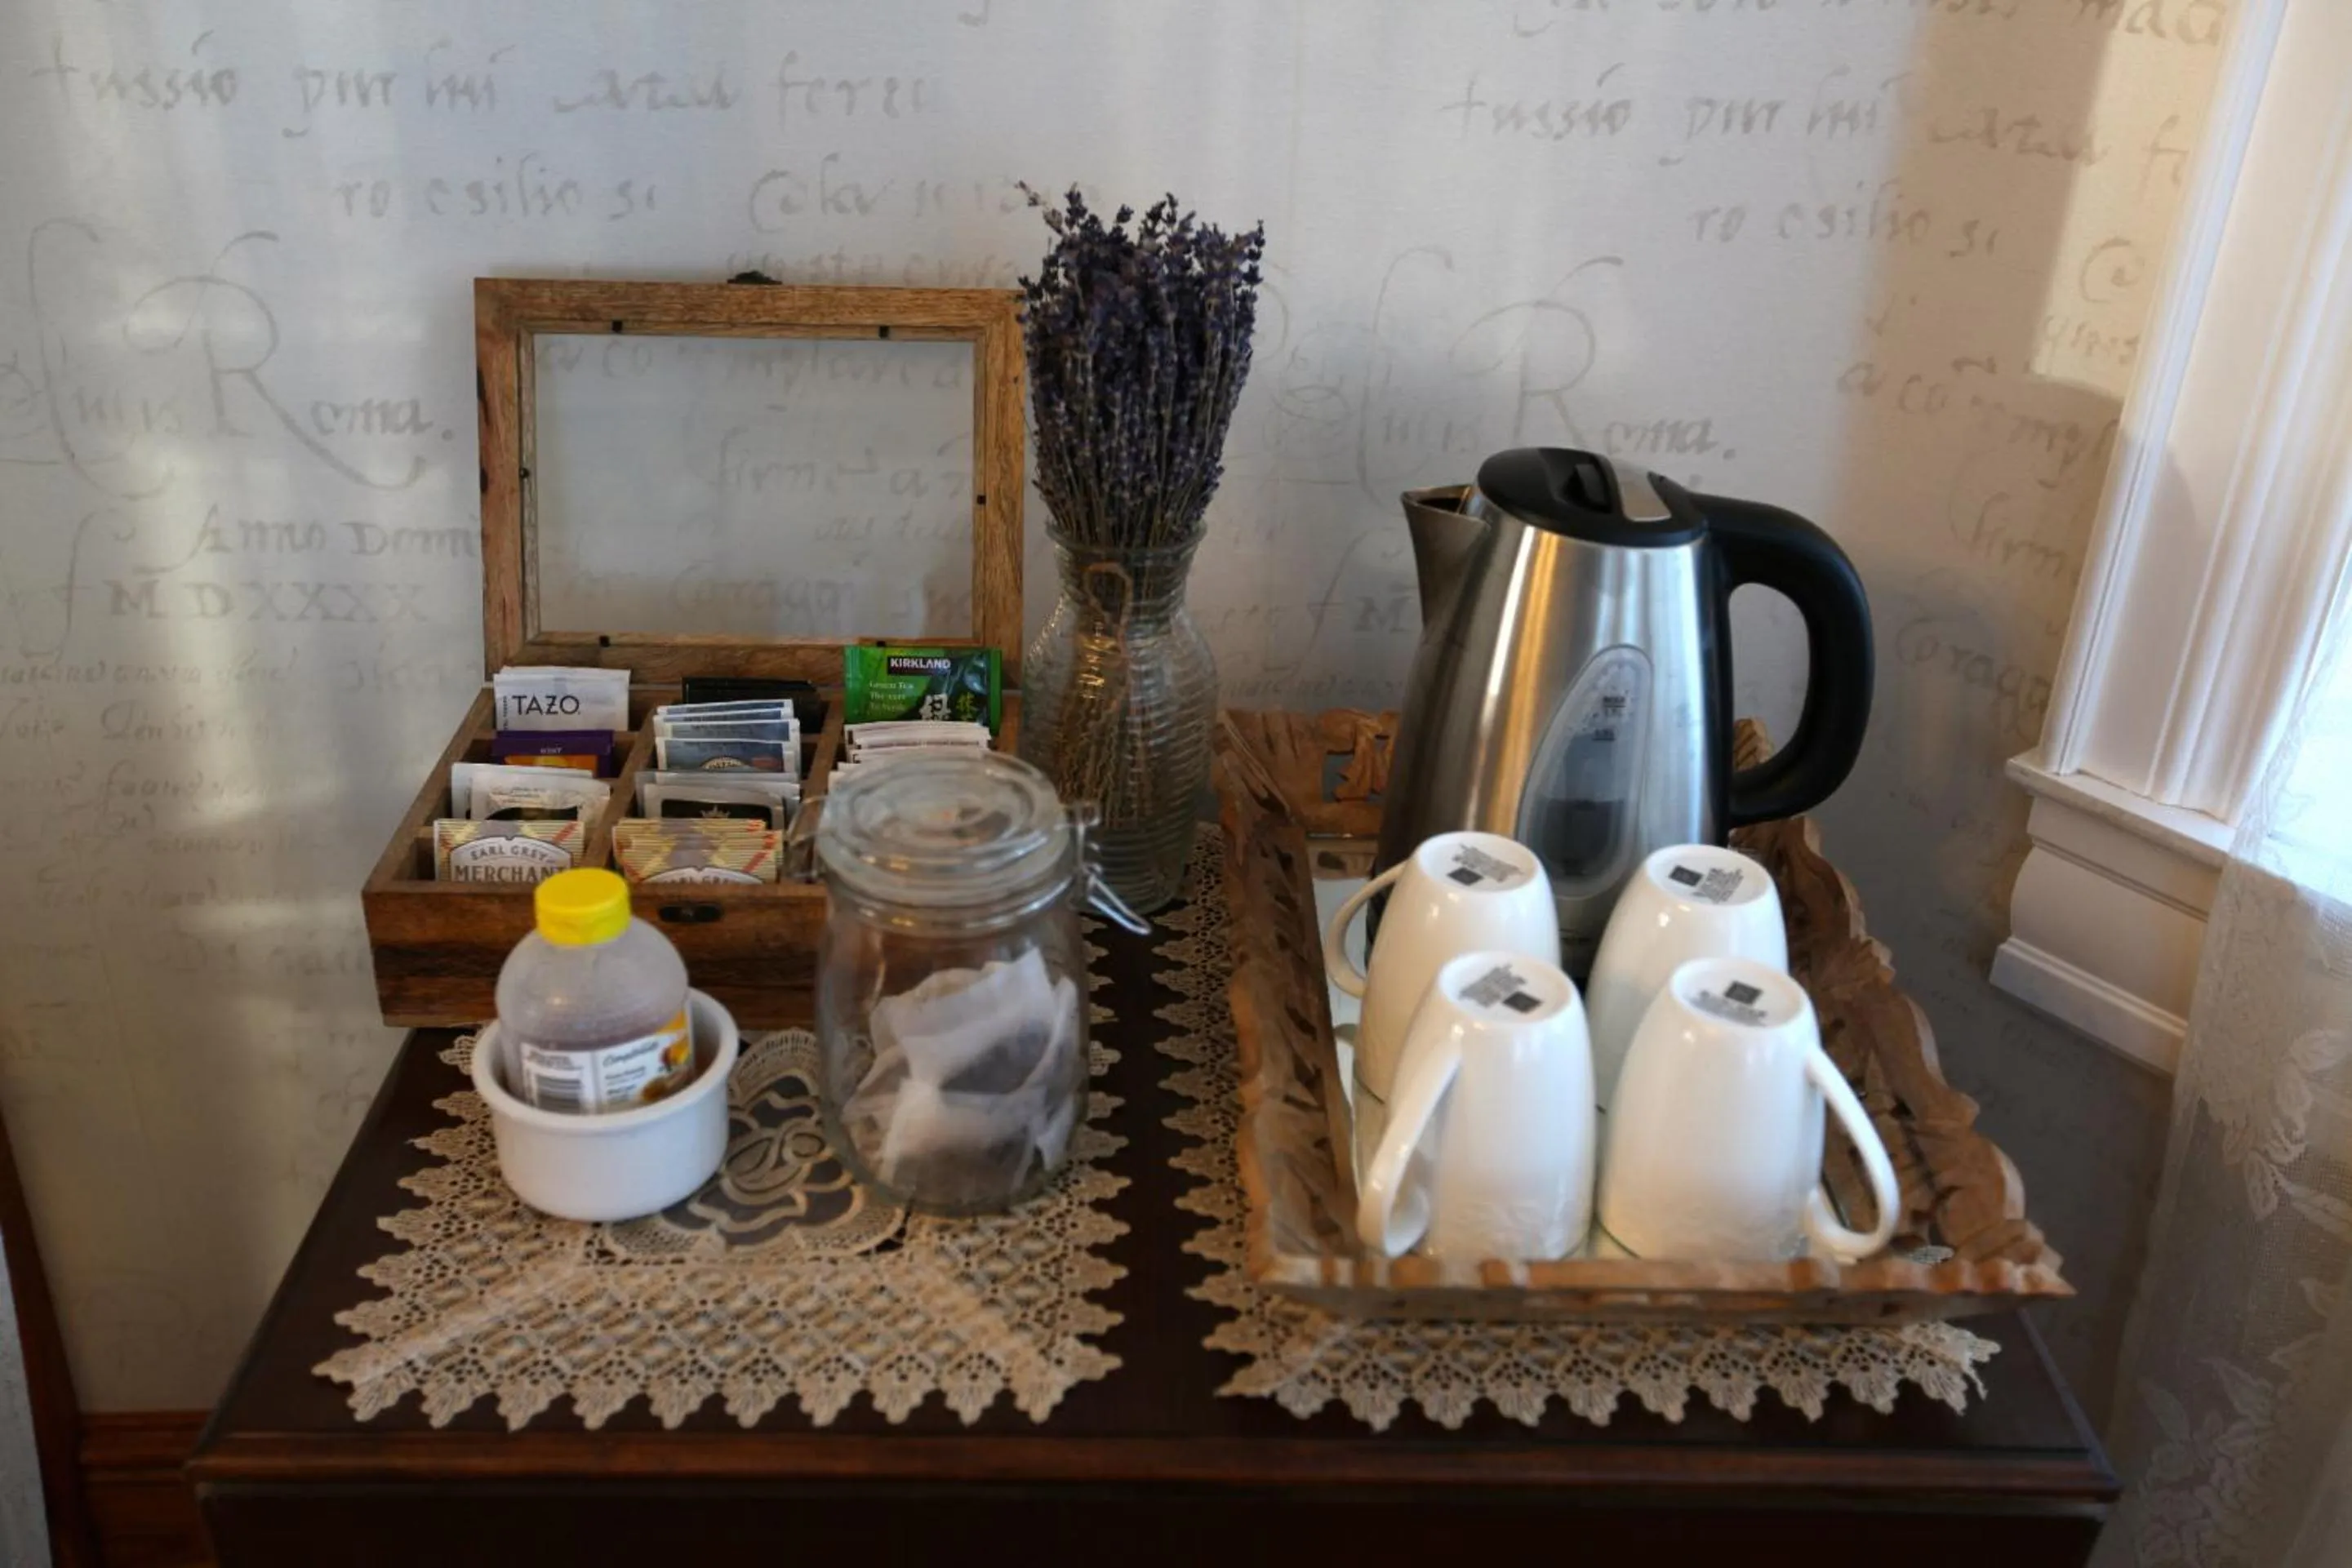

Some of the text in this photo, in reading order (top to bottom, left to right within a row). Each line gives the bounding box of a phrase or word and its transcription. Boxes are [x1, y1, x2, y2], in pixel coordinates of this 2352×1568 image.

[890, 658, 951, 669] KIRKLAND
[512, 695, 580, 716] TAZO
[470, 844, 549, 861] EARL GREY
